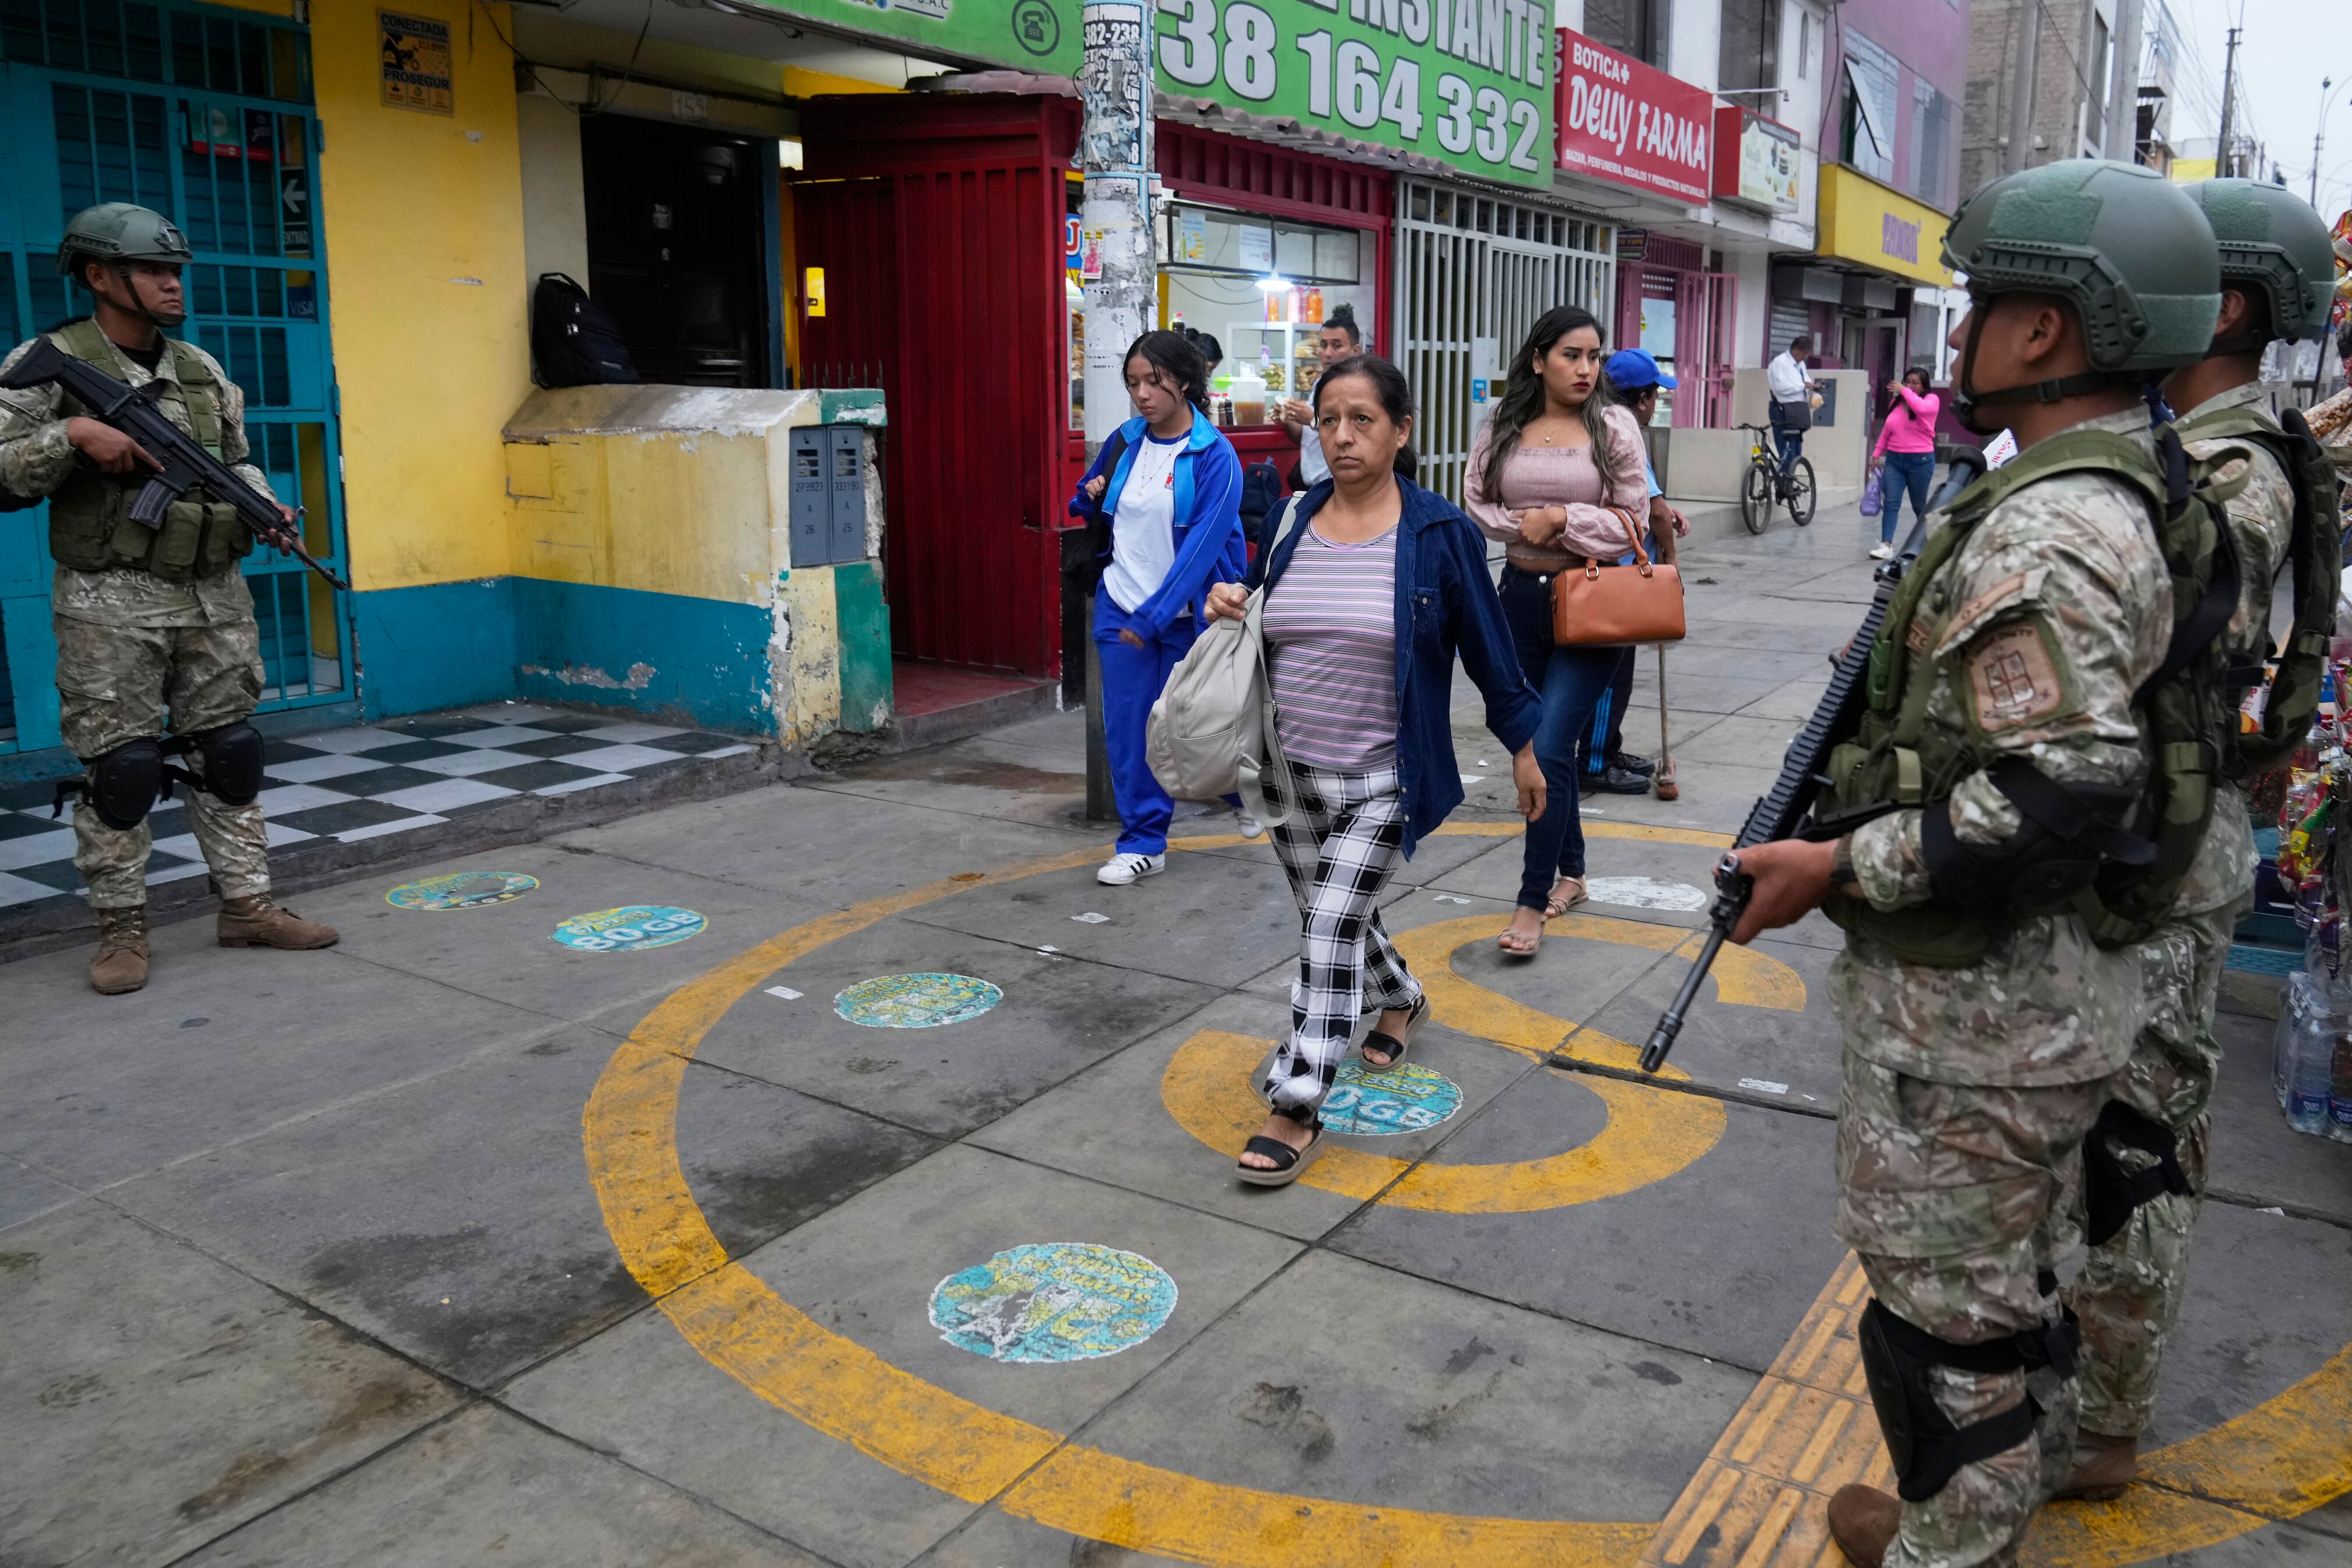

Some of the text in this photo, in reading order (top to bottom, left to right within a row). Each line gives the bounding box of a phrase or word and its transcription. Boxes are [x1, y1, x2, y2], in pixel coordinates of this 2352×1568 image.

[381, 13, 448, 39] CONECTADA
[384, 69, 450, 90] PROSEGUR
[1296, 28, 1423, 142] 164
[1437, 73, 1540, 173] 332
[1637, 101, 1706, 171] FARMA
[1566, 149, 1587, 167] BAZAR,
[1624, 166, 1647, 182] REGALOS
[1647, 172, 1652, 182] Y
[1652, 173, 1679, 190] PRODUCTOS
[288, 300, 314, 316] VISA
[795, 482, 824, 492] 279923
[807, 504, 812, 512] A
[844, 501, 850, 509] A
[573, 927, 644, 950] 80
